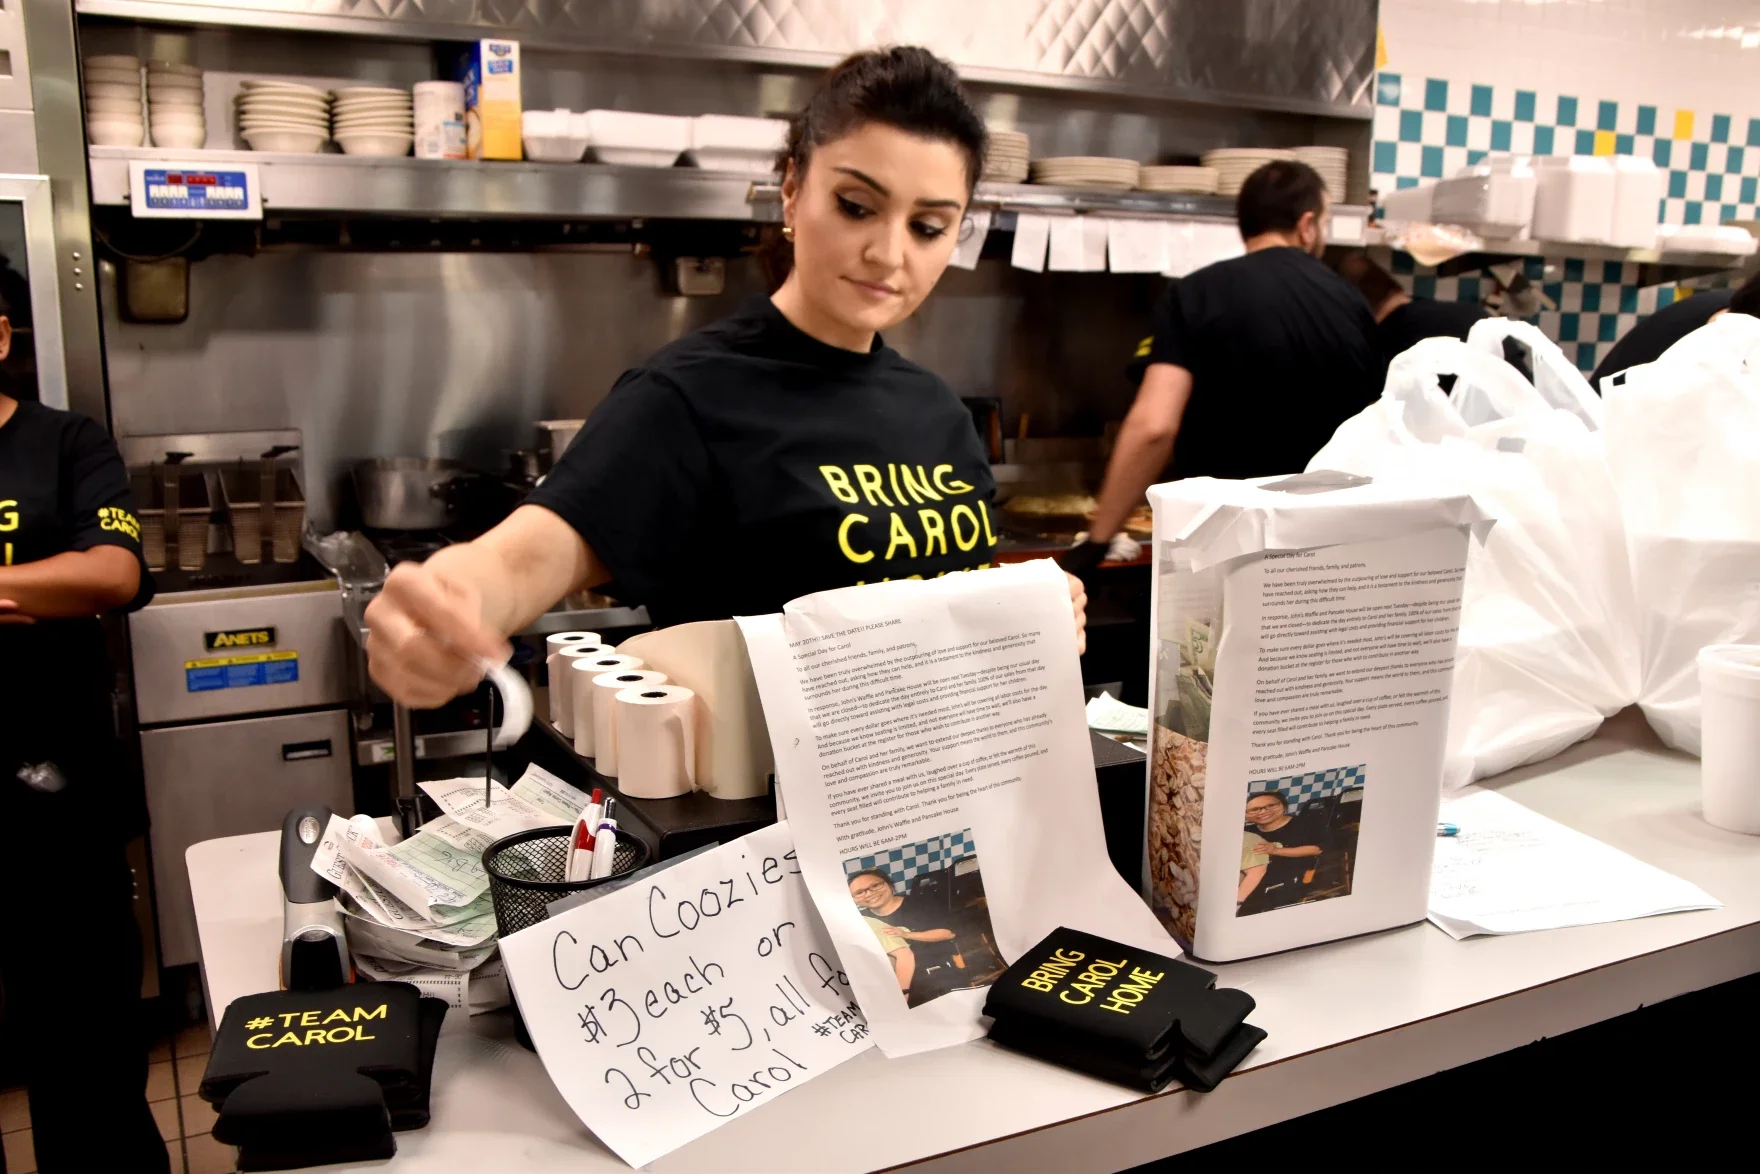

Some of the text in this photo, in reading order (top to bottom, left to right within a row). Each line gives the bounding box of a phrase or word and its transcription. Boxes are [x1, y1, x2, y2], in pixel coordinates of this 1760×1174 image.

[819, 463, 975, 508] BRING
[838, 500, 998, 564] CAROL
[1269, 551, 1285, 560] Special
[1285, 551, 1295, 559] Day
[213, 631, 269, 648] ANETS
[821, 632, 836, 641] SAVE
[865, 622, 884, 630] PLEASE
[884, 618, 902, 627] SHARE
[797, 650, 817, 660] Special
[836, 642, 852, 650] Carol
[821, 656, 847, 667] cherished
[851, 660, 886, 673] overwhelmed
[903, 651, 932, 662] outpouring
[955, 643, 972, 651] support
[988, 636, 1007, 645] beloved
[804, 690, 832, 700] surrounds
[841, 683, 860, 692] during
[870, 676, 890, 686] difficult
[856, 693, 874, 702] Waffle
[884, 686, 906, 695] Pancake
[833, 820, 850, 829] Thank
[870, 810, 893, 820] standing
[921, 799, 938, 807] Thank
[956, 791, 970, 799] being
[893, 818, 911, 828] Waffle
[911, 815, 922, 824] and
[921, 811, 942, 820] Pancake
[839, 845, 859, 855] HOURS
[880, 833, 907, 845] 6AM-2PM
[552, 930, 644, 990] Can
[1021, 948, 1086, 993] BRING
[578, 921, 795, 1048] $3 each or
[1059, 958, 1128, 1005] CAROL
[1099, 967, 1165, 1015] HOME
[245, 1004, 389, 1031] #TEAM
[604, 1067, 652, 1110] 2
[636, 1046, 700, 1085] for
[770, 974, 810, 1027] all
[808, 952, 850, 996] fo
[811, 1001, 861, 1037] #TEAM
[246, 1026, 376, 1050] CAROL
[839, 1023, 869, 1044] CAR
[688, 1048, 808, 1118] Carol
